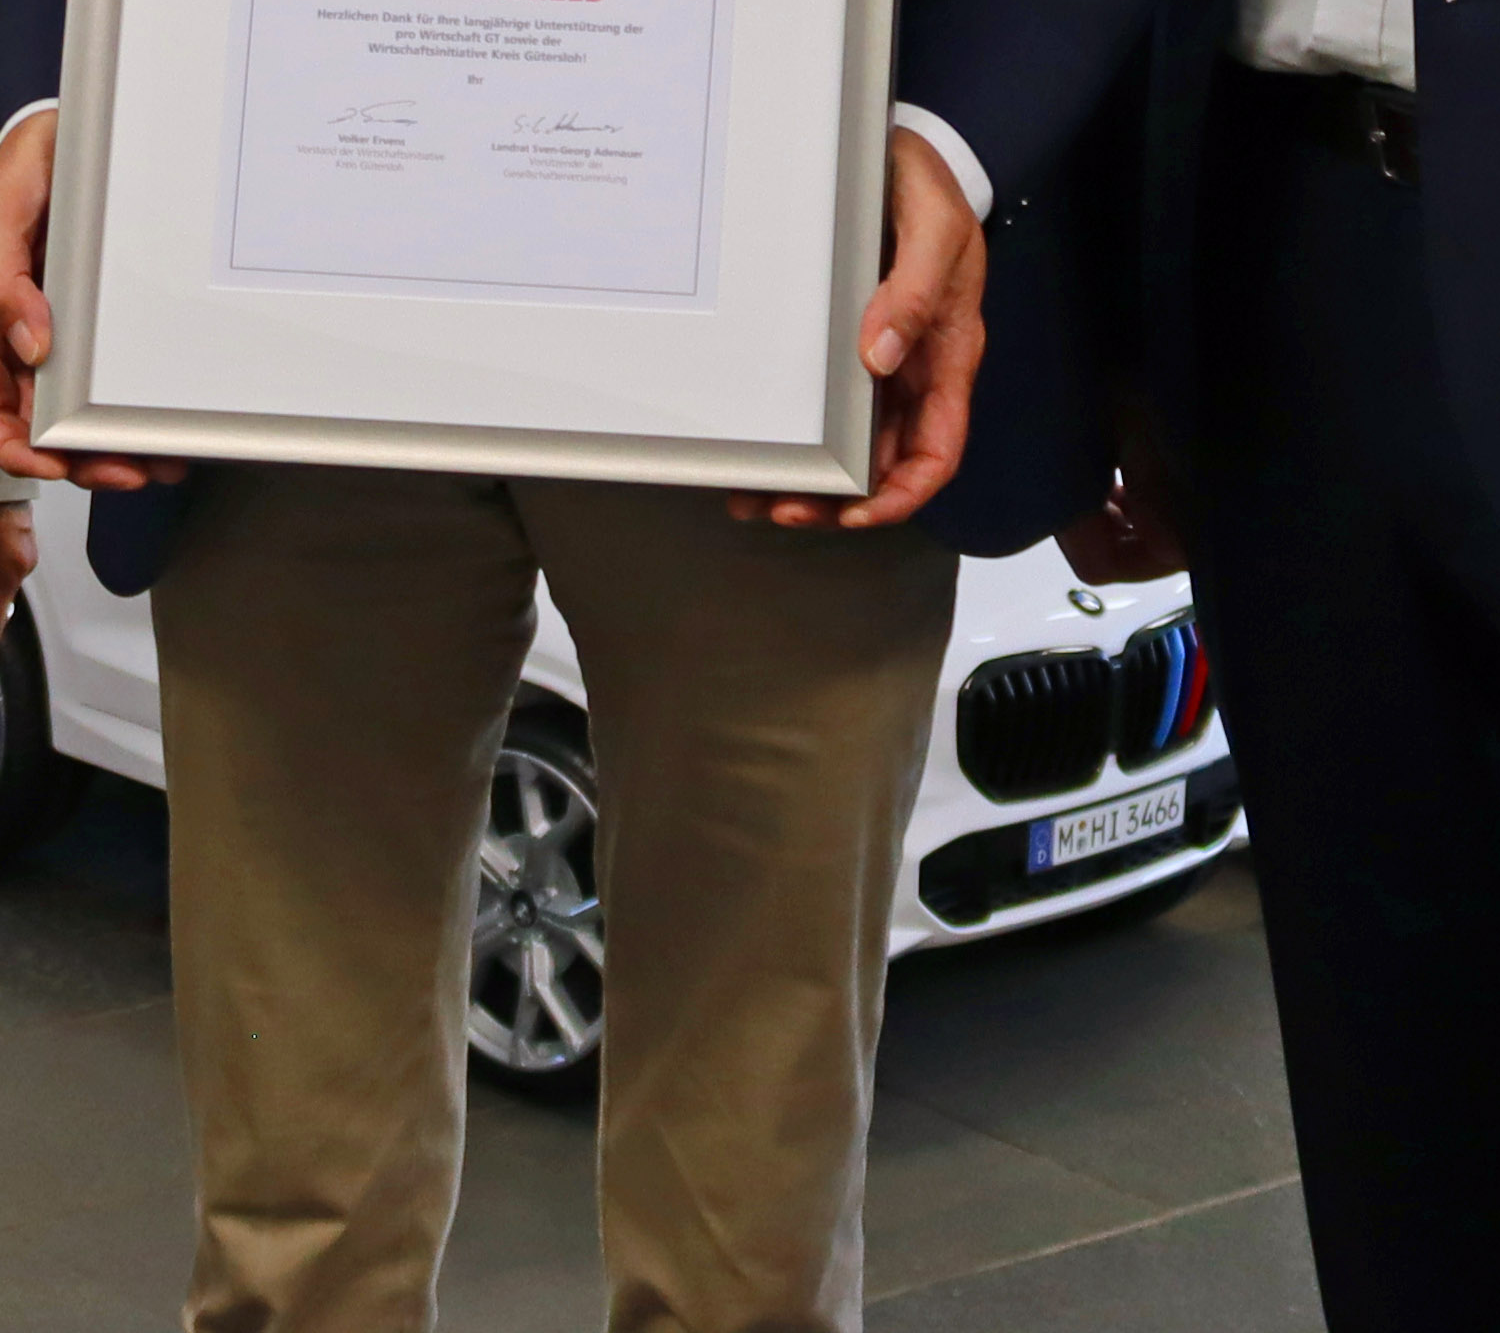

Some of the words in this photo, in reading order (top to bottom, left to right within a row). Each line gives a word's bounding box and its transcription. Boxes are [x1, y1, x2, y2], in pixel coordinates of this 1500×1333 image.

[317, 9, 379, 22] Herzlichen
[382, 12, 413, 24] Dank
[417, 13, 433, 24] für
[437, 15, 460, 27] Ihre
[464, 16, 530, 31] langjährige
[534, 19, 620, 35] Unterstützung
[624, 23, 643, 34] der
[396, 31, 415, 43] pro
[419, 29, 480, 42] Wirtschaft
[484, 32, 499, 43] GT
[503, 34, 539, 46] sowie
[542, 35, 562, 46] der
[368, 42, 487, 60] Wirtschaftsinitiative
[492, 49, 520, 61] Kreis
[524, 51, 587, 64] Gütersloh!
[467, 75, 484, 85] Ihr
[1126, 791, 1180, 836] 3466
[1037, 850, 1047, 864] D
